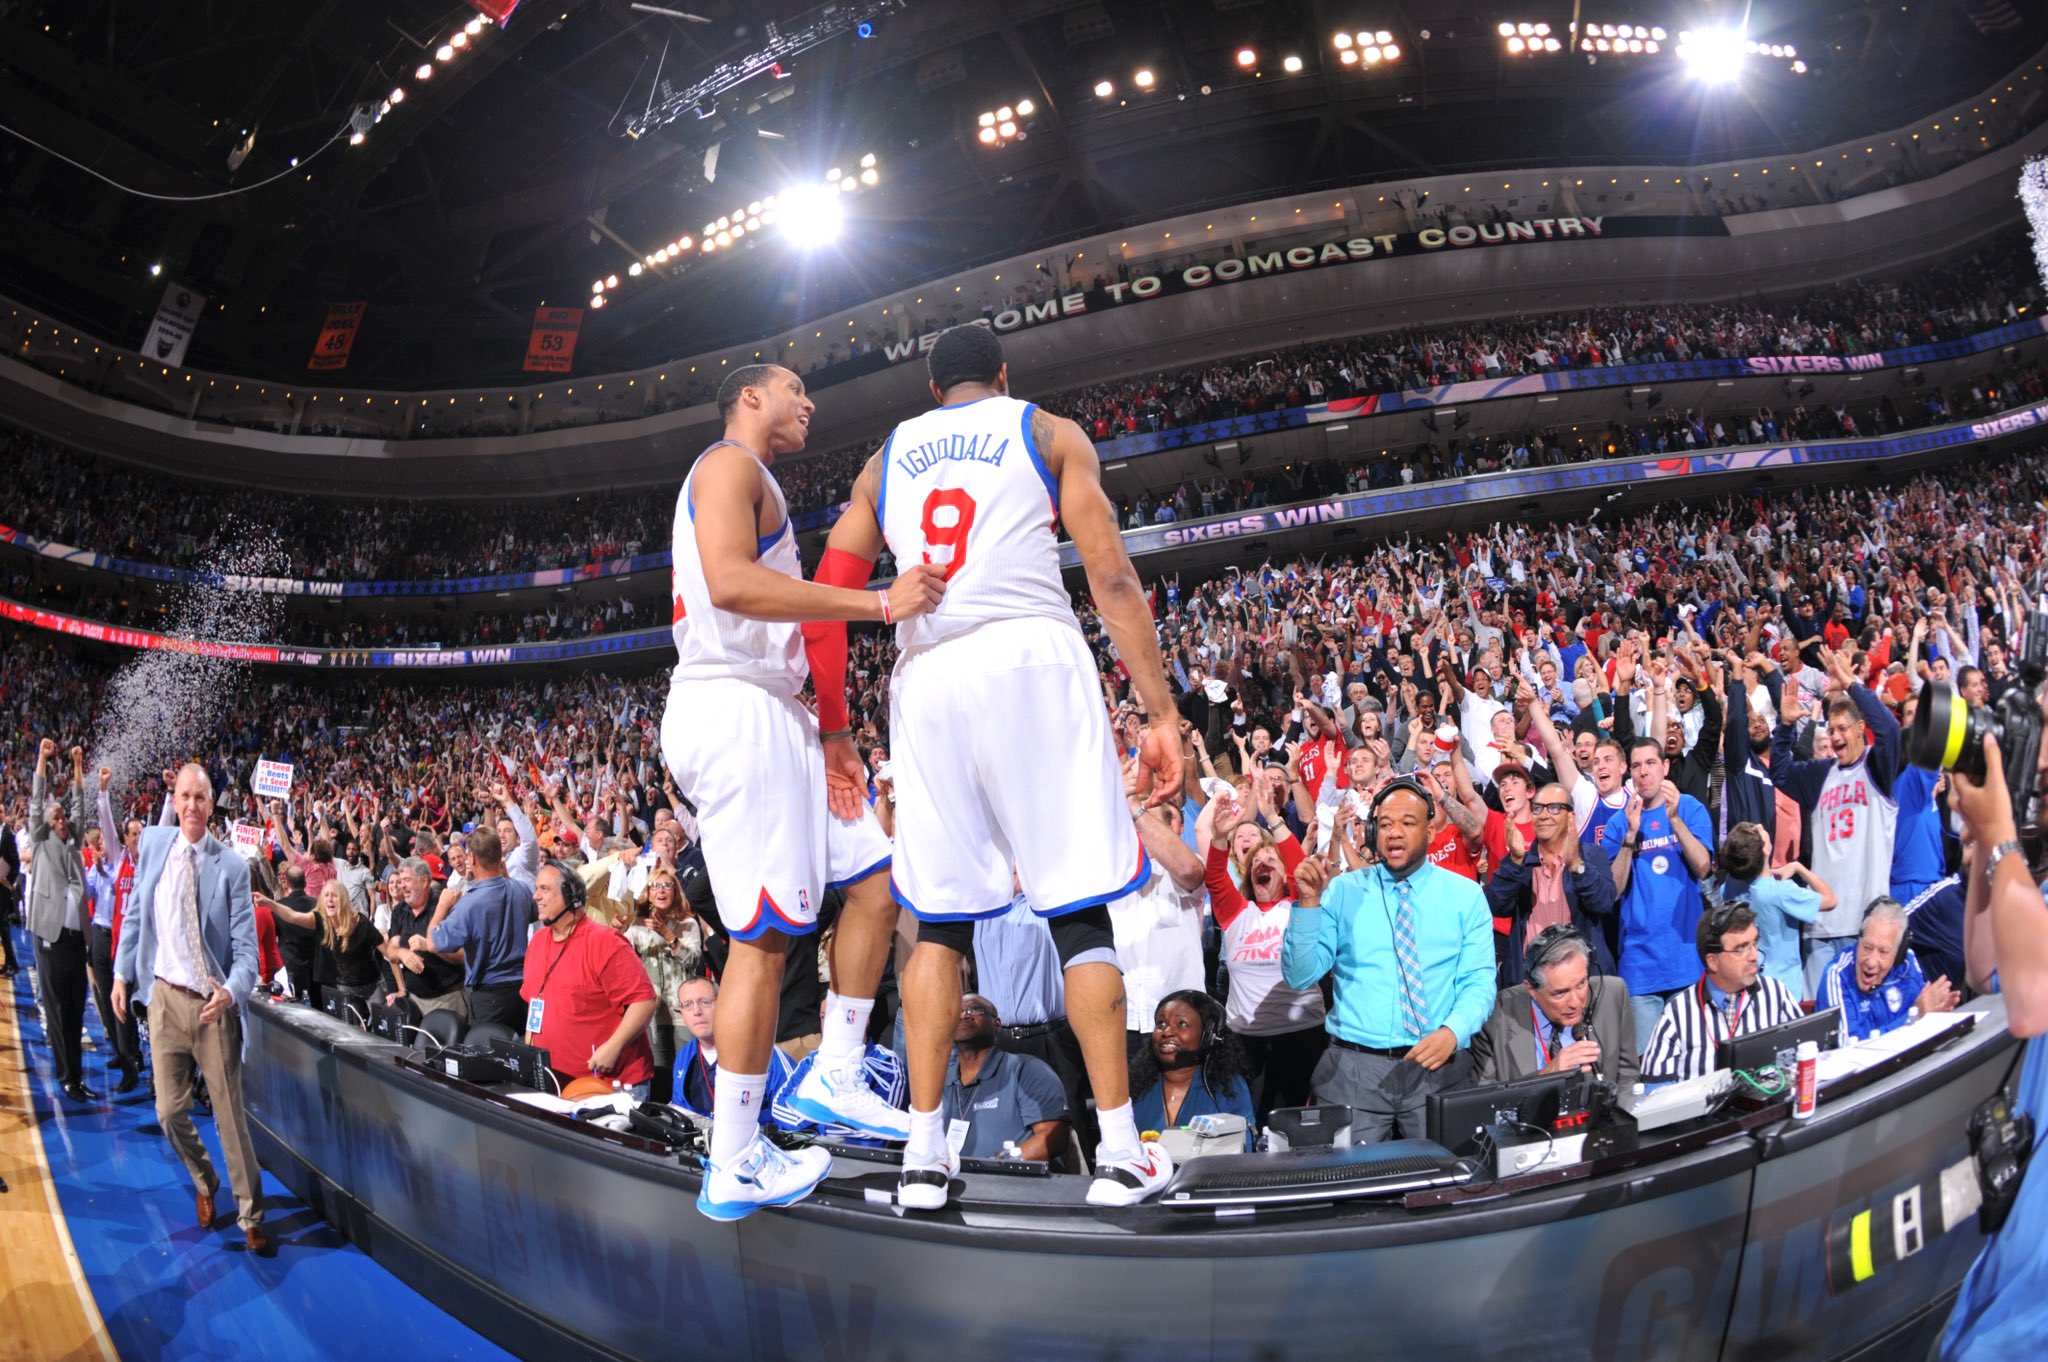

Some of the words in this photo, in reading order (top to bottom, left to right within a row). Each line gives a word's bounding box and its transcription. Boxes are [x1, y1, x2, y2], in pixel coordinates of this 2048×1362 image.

[884, 292, 1087, 363] WEOME
[1104, 275, 1163, 303] TO
[1182, 234, 1398, 288] COMCAST
[1418, 216, 1604, 248] COUNTRY
[324, 333, 346, 351] 48
[541, 334, 564, 352] 53
[1747, 355, 1845, 375] SIXERS
[1845, 352, 1885, 371] WIN
[1971, 410, 2036, 439] SIXERS
[897, 433, 1010, 480] IGUODALA
[920, 487, 977, 583] 9
[1164, 514, 1266, 547] SIXERS
[1274, 501, 1345, 529] WIN
[224, 574, 304, 595] SIXERS
[309, 581, 344, 596] WIN
[393, 651, 465, 667] SIXERS
[471, 648, 511, 663] WIN
[1828, 808, 1855, 842] 13
